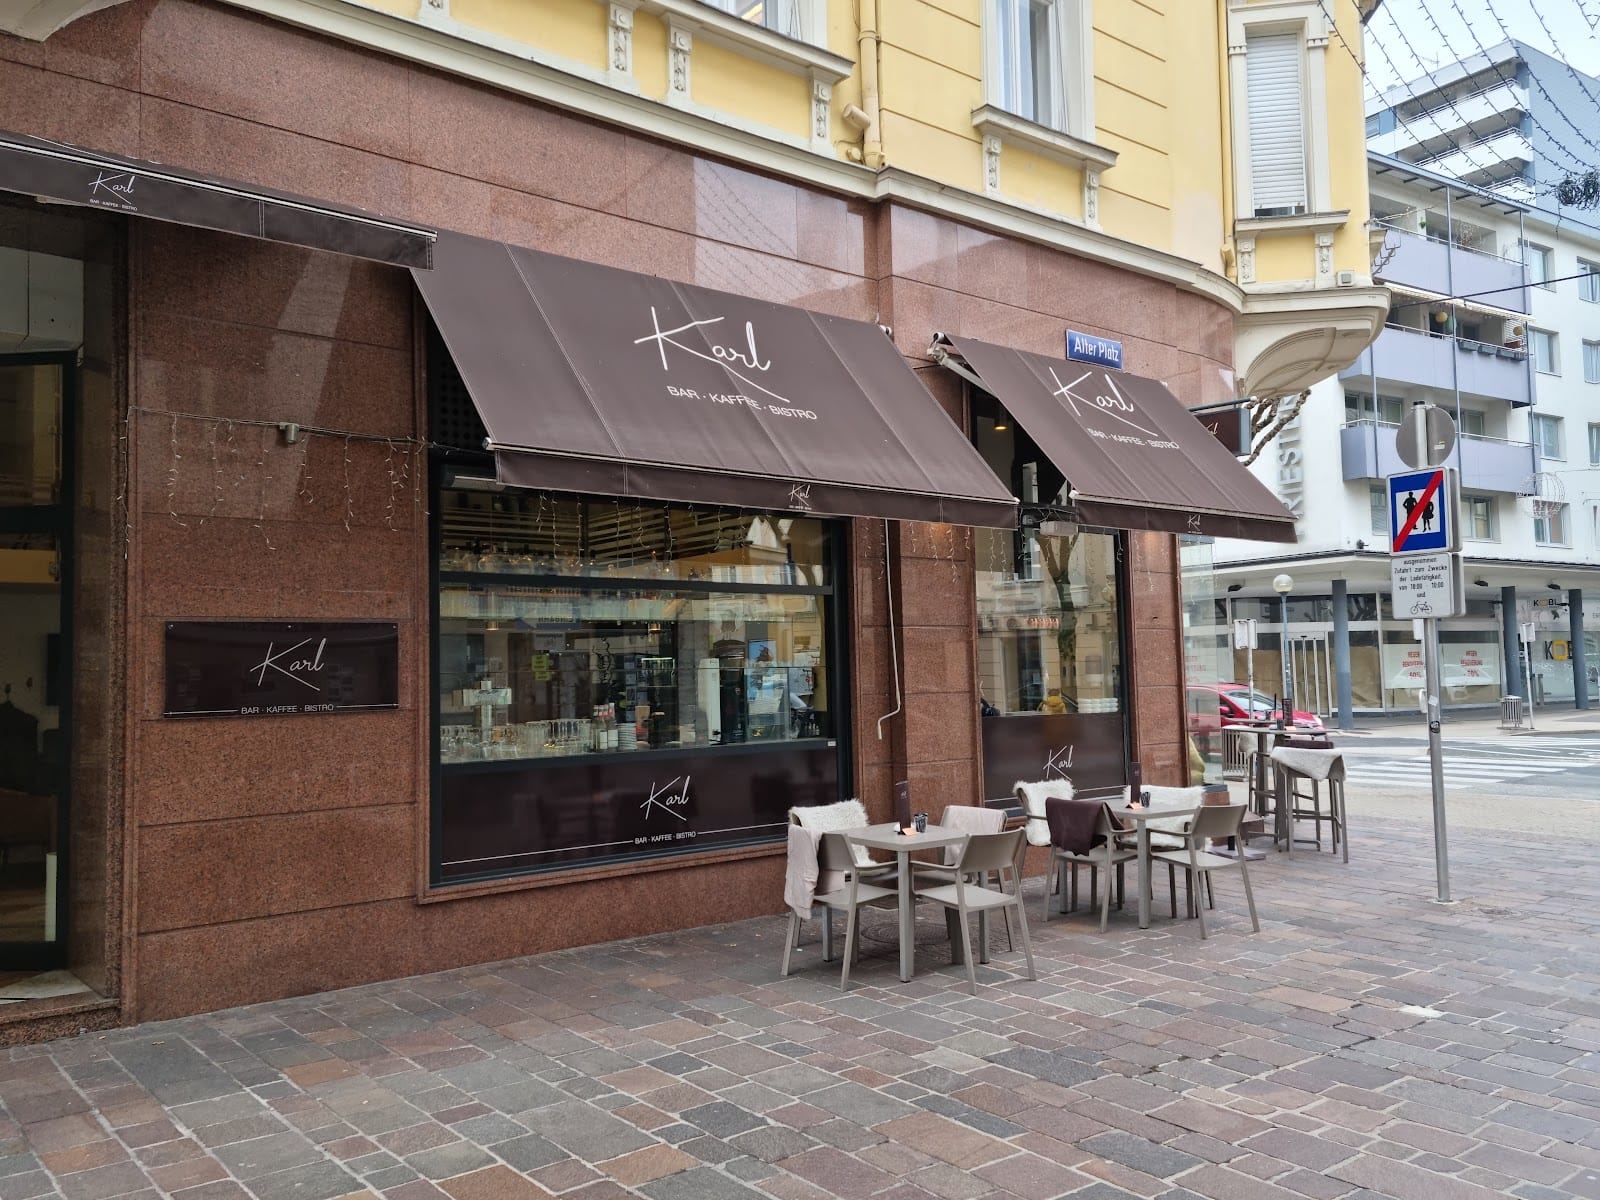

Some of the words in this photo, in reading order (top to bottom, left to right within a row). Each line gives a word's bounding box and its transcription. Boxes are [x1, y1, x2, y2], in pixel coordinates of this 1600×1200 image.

[88, 171, 135, 205] Karl
[634, 306, 790, 403] Karl
[1074, 336, 1096, 356] Alter
[1099, 342, 1119, 362] Platz
[667, 386, 700, 400] BAR
[709, 393, 762, 410] KAFFEE
[768, 405, 817, 420] BISTRO
[1049, 366, 1159, 437] Karl
[1087, 428, 1108, 440] BAR
[1110, 434, 1145, 446] KAFFEE
[1147, 439, 1180, 450] BISTRO
[788, 484, 810, 507] Karl
[250, 637, 326, 691] Karl
[241, 706, 259, 714] BAR
[266, 705, 298, 713] KAFFEE
[304, 704, 334, 712] BISTRO
[1043, 744, 1073, 781] Karl
[640, 775, 690, 821] Karl
[634, 837, 647, 845] BAR
[651, 834, 672, 842] KAFFEE
[676, 831, 696, 839] BISTRO
